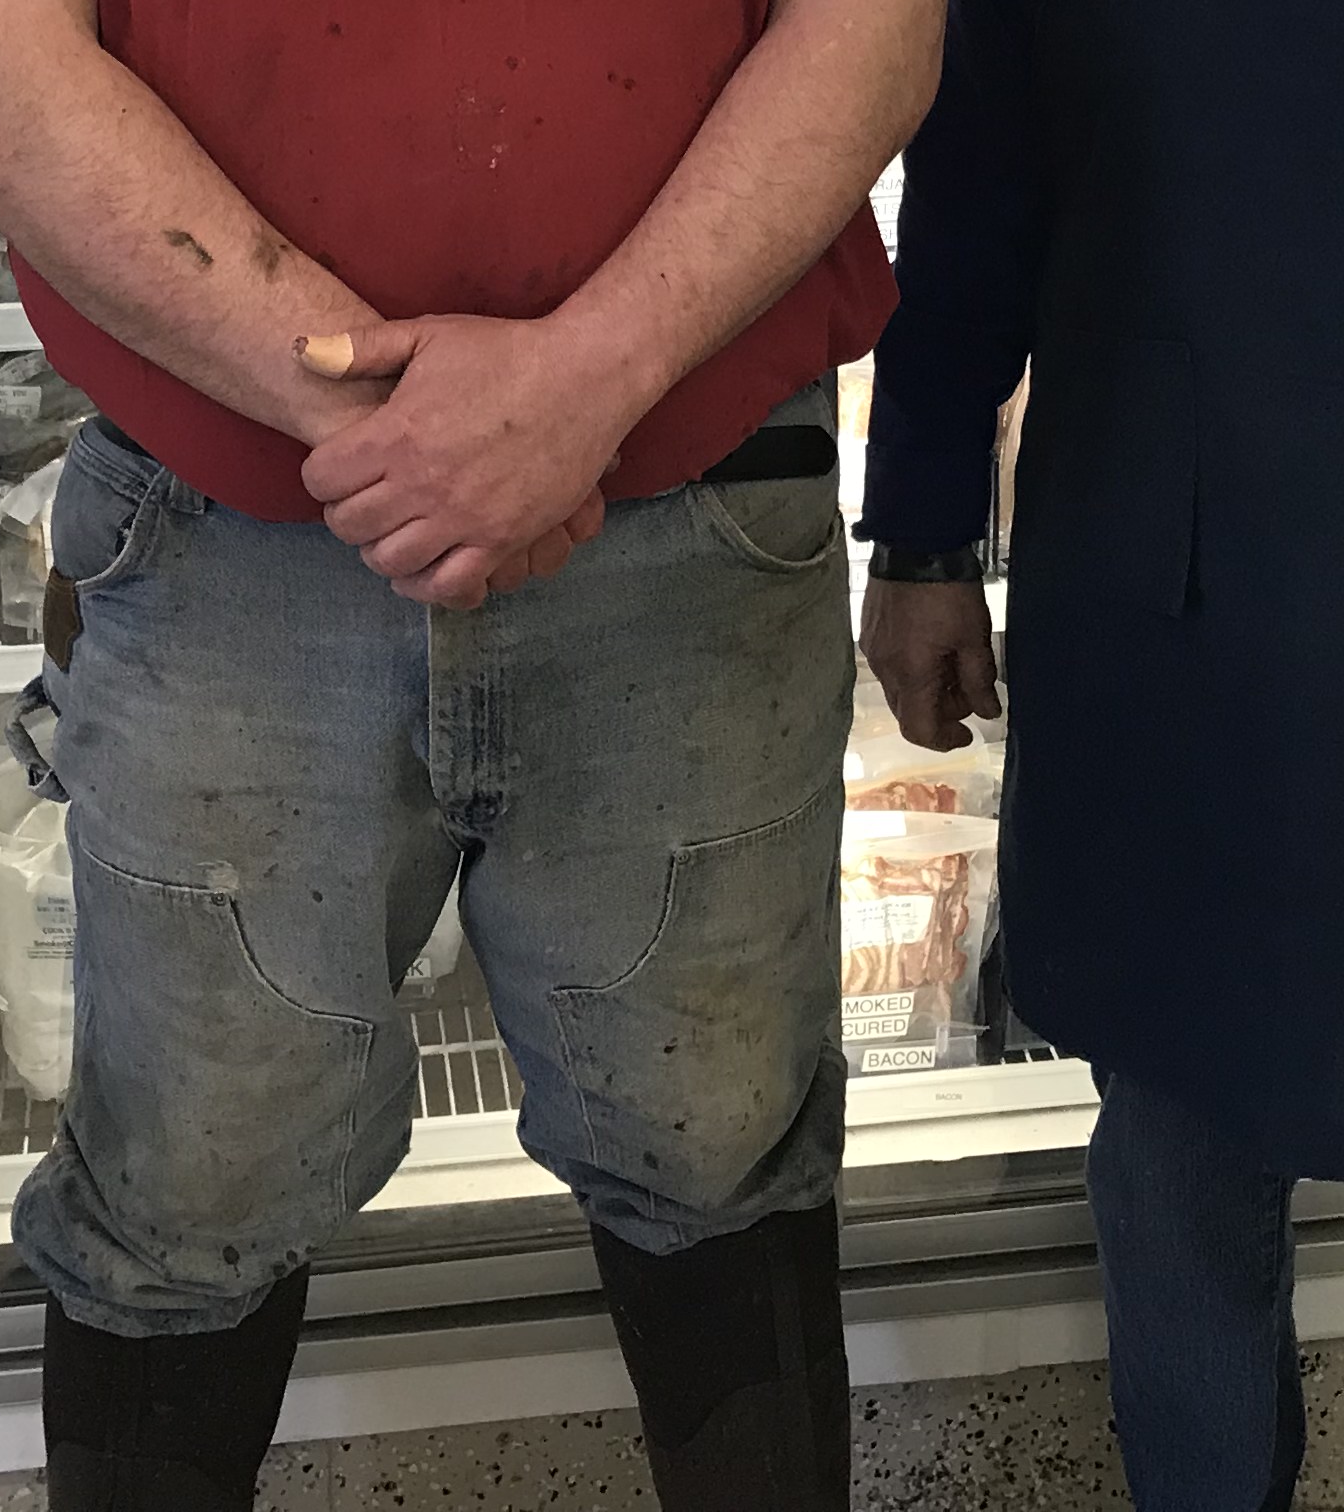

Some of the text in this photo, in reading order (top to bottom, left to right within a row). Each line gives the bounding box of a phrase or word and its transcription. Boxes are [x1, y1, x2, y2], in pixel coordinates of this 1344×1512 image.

[842, 996, 912, 1014] MOKED
[842, 1019, 906, 1037] CURED
[868, 1050, 933, 1068] BACON
